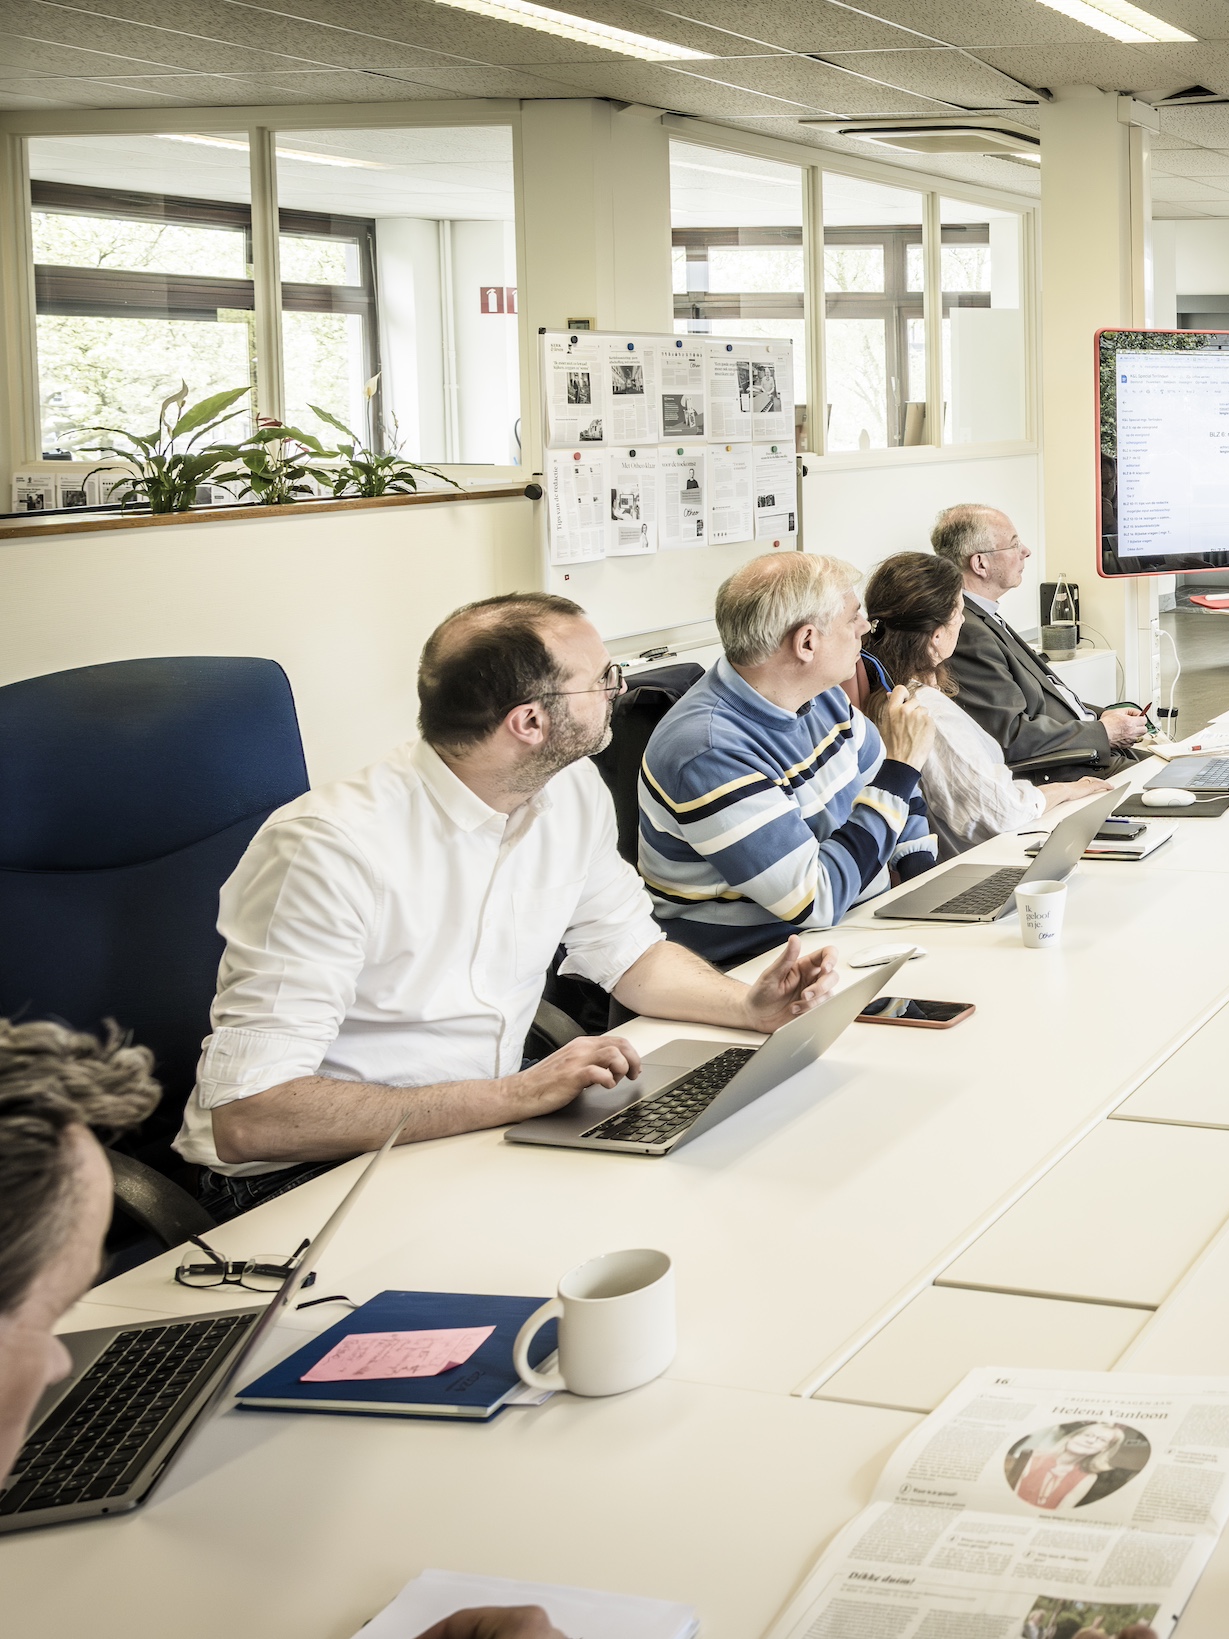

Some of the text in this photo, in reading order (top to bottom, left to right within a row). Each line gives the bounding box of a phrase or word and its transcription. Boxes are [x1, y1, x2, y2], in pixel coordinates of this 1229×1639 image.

[554, 494, 559, 503] de
[1026, 911, 1050, 920] geloof
[1034, 921, 1043, 929] je.
[993, 1377, 1009, 1386] 16
[1052, 1406, 1169, 1420] Helena Vanloon
[847, 1571, 916, 1586] Dikke duim!
